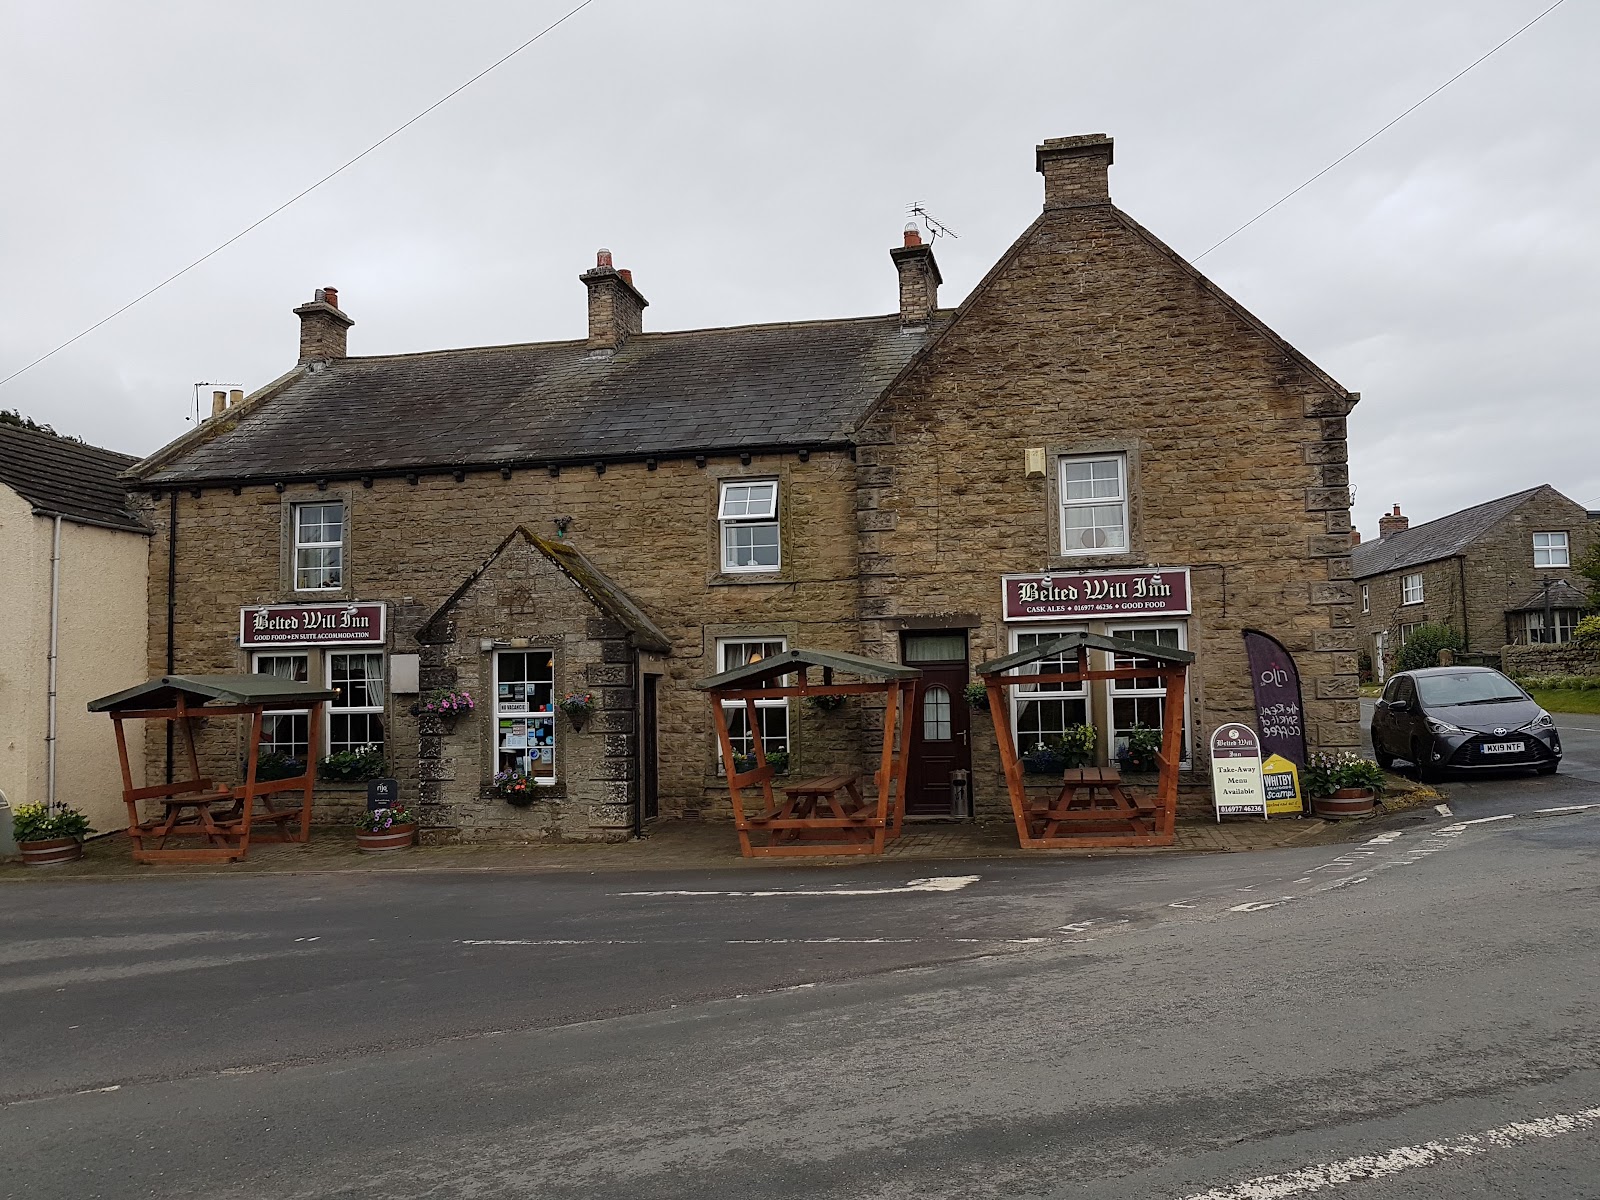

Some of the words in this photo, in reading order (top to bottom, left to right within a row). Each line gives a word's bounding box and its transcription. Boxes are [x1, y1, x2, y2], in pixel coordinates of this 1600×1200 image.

[1017, 582, 1078, 605] Belted
[1082, 579, 1128, 600] Will
[1132, 577, 1172, 598] Inn
[1121, 602, 1144, 610] GOOD
[1144, 601, 1166, 609] FOOD
[252, 612, 299, 633] Belted
[302, 611, 336, 629] Will
[339, 610, 370, 628] Inn
[1216, 739, 1237, 747] Belted
[1238, 738, 1253, 746] Will
[1487, 744, 1505, 752] MX19
[1506, 743, 1521, 751] NTF
[1263, 774, 1292, 787] WHITBY
